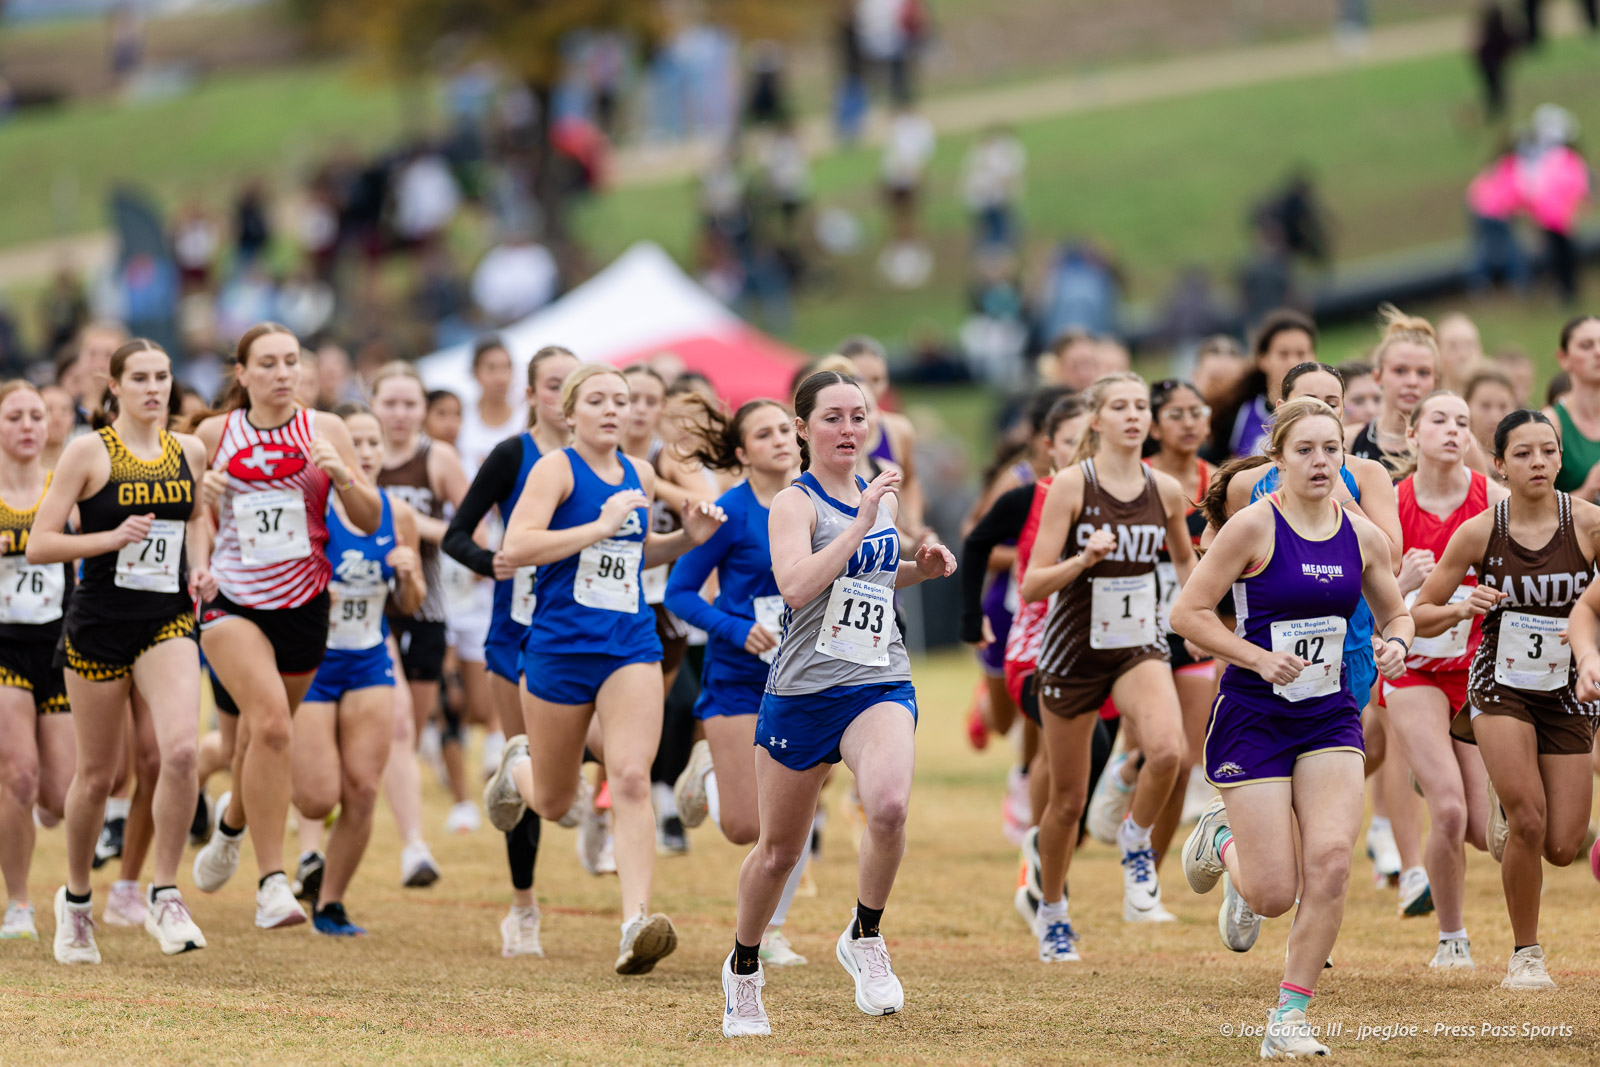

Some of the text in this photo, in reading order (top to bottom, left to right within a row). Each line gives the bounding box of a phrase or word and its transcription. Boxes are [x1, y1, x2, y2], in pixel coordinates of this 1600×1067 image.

[118, 480, 192, 506] GRADY
[256, 508, 283, 533] 37
[140, 538, 166, 563] 79
[598, 555, 625, 580] 98
[1302, 563, 1342, 574] MEADOW
[16, 570, 43, 594] 76
[863, 584, 881, 594] Region
[853, 590, 888, 603] Championship
[1122, 594, 1132, 618] 1
[342, 600, 367, 620] 99
[838, 598, 884, 633] 133
[1532, 617, 1554, 625] Region
[1294, 626, 1337, 636] Championship
[1304, 620, 1326, 628] Region
[1521, 623, 1564, 632] Championshi
[1294, 637, 1324, 665] 92
[1527, 633, 1543, 659] 3
